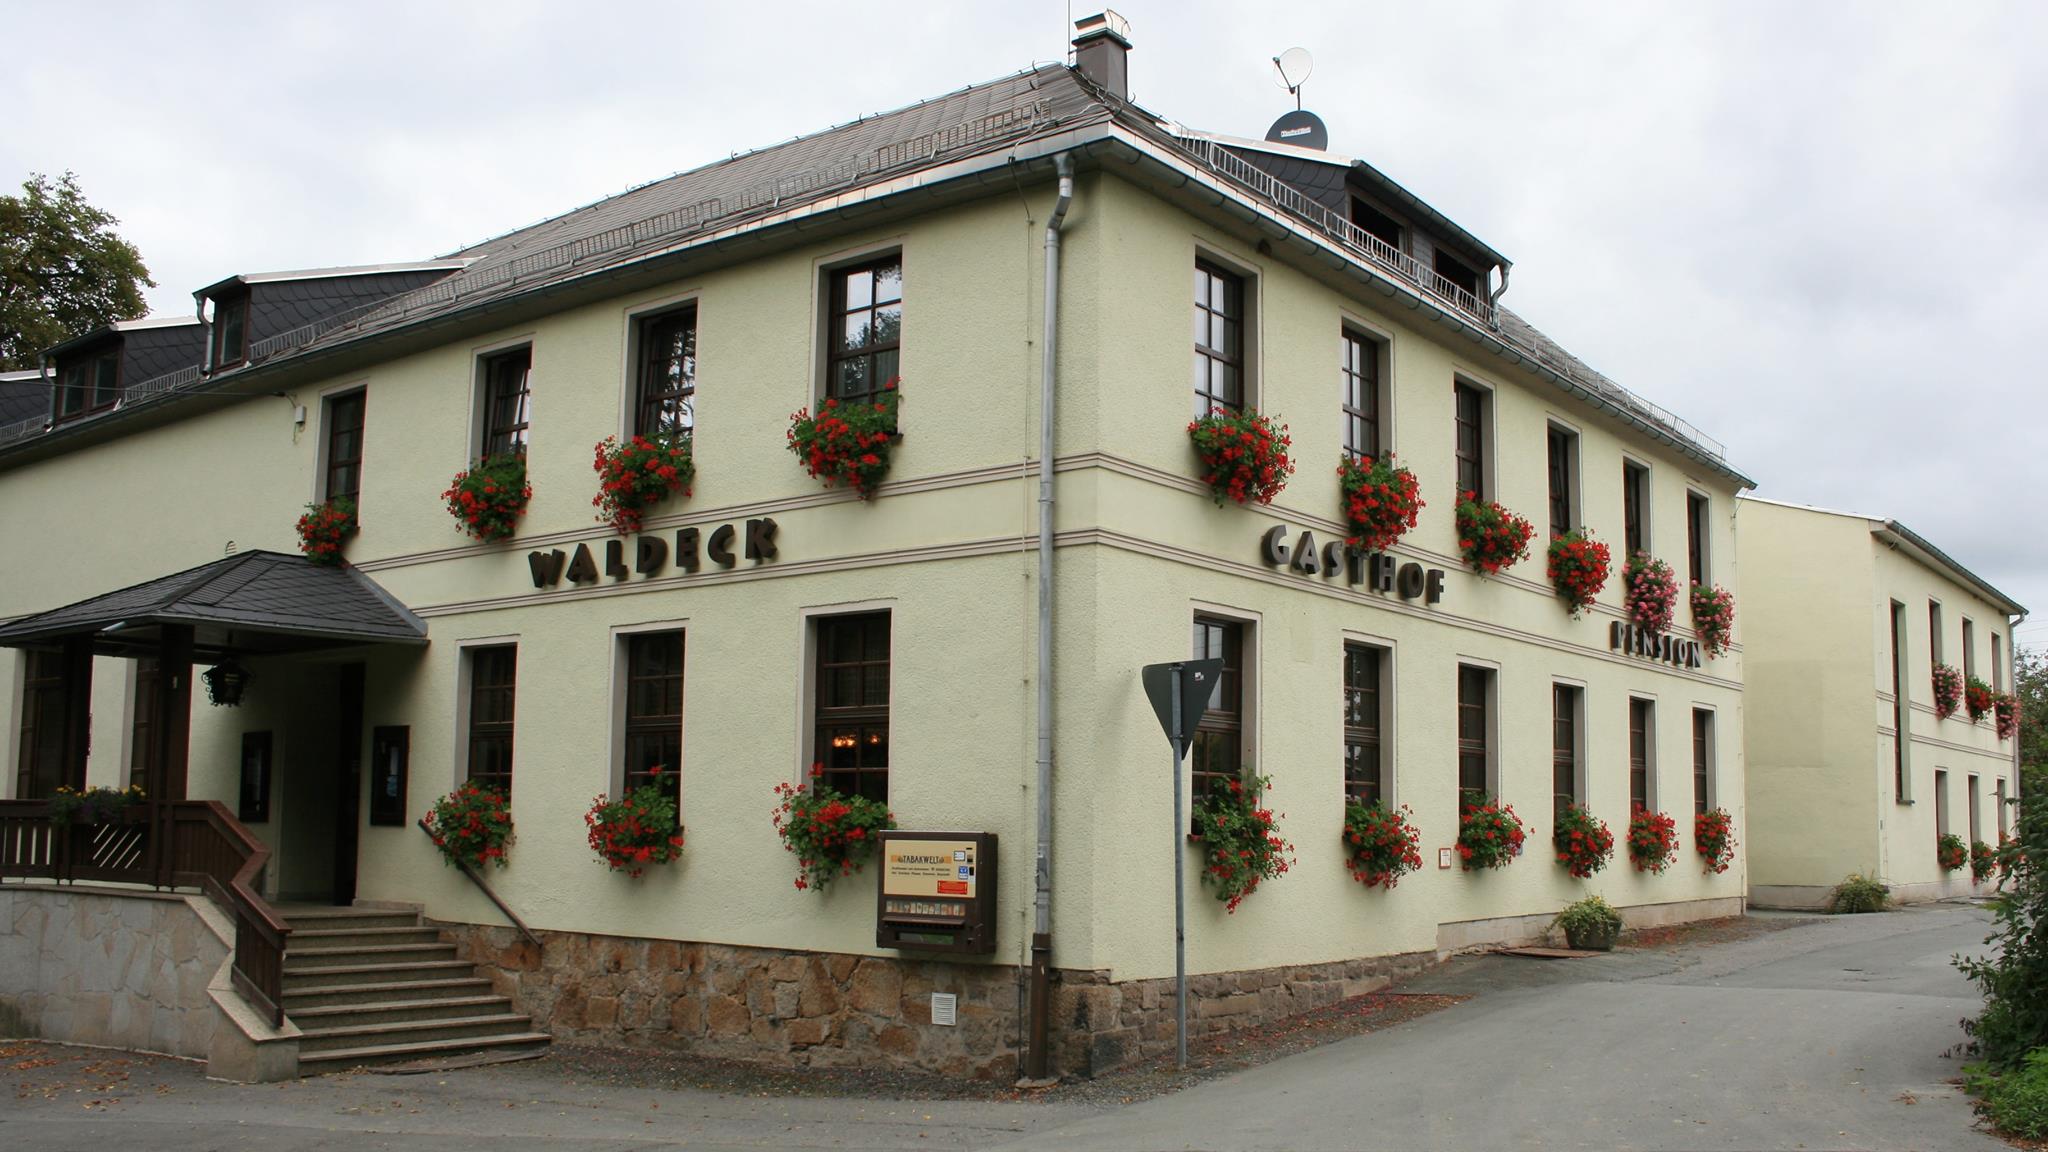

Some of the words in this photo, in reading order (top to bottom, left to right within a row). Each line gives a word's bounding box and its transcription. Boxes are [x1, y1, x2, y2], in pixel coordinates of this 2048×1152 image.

[528, 517, 778, 588] WALDECK
[1262, 524, 1445, 604] GASTHOF
[1609, 620, 1701, 668] PENSION
[903, 855, 939, 864] TABAKWELT
